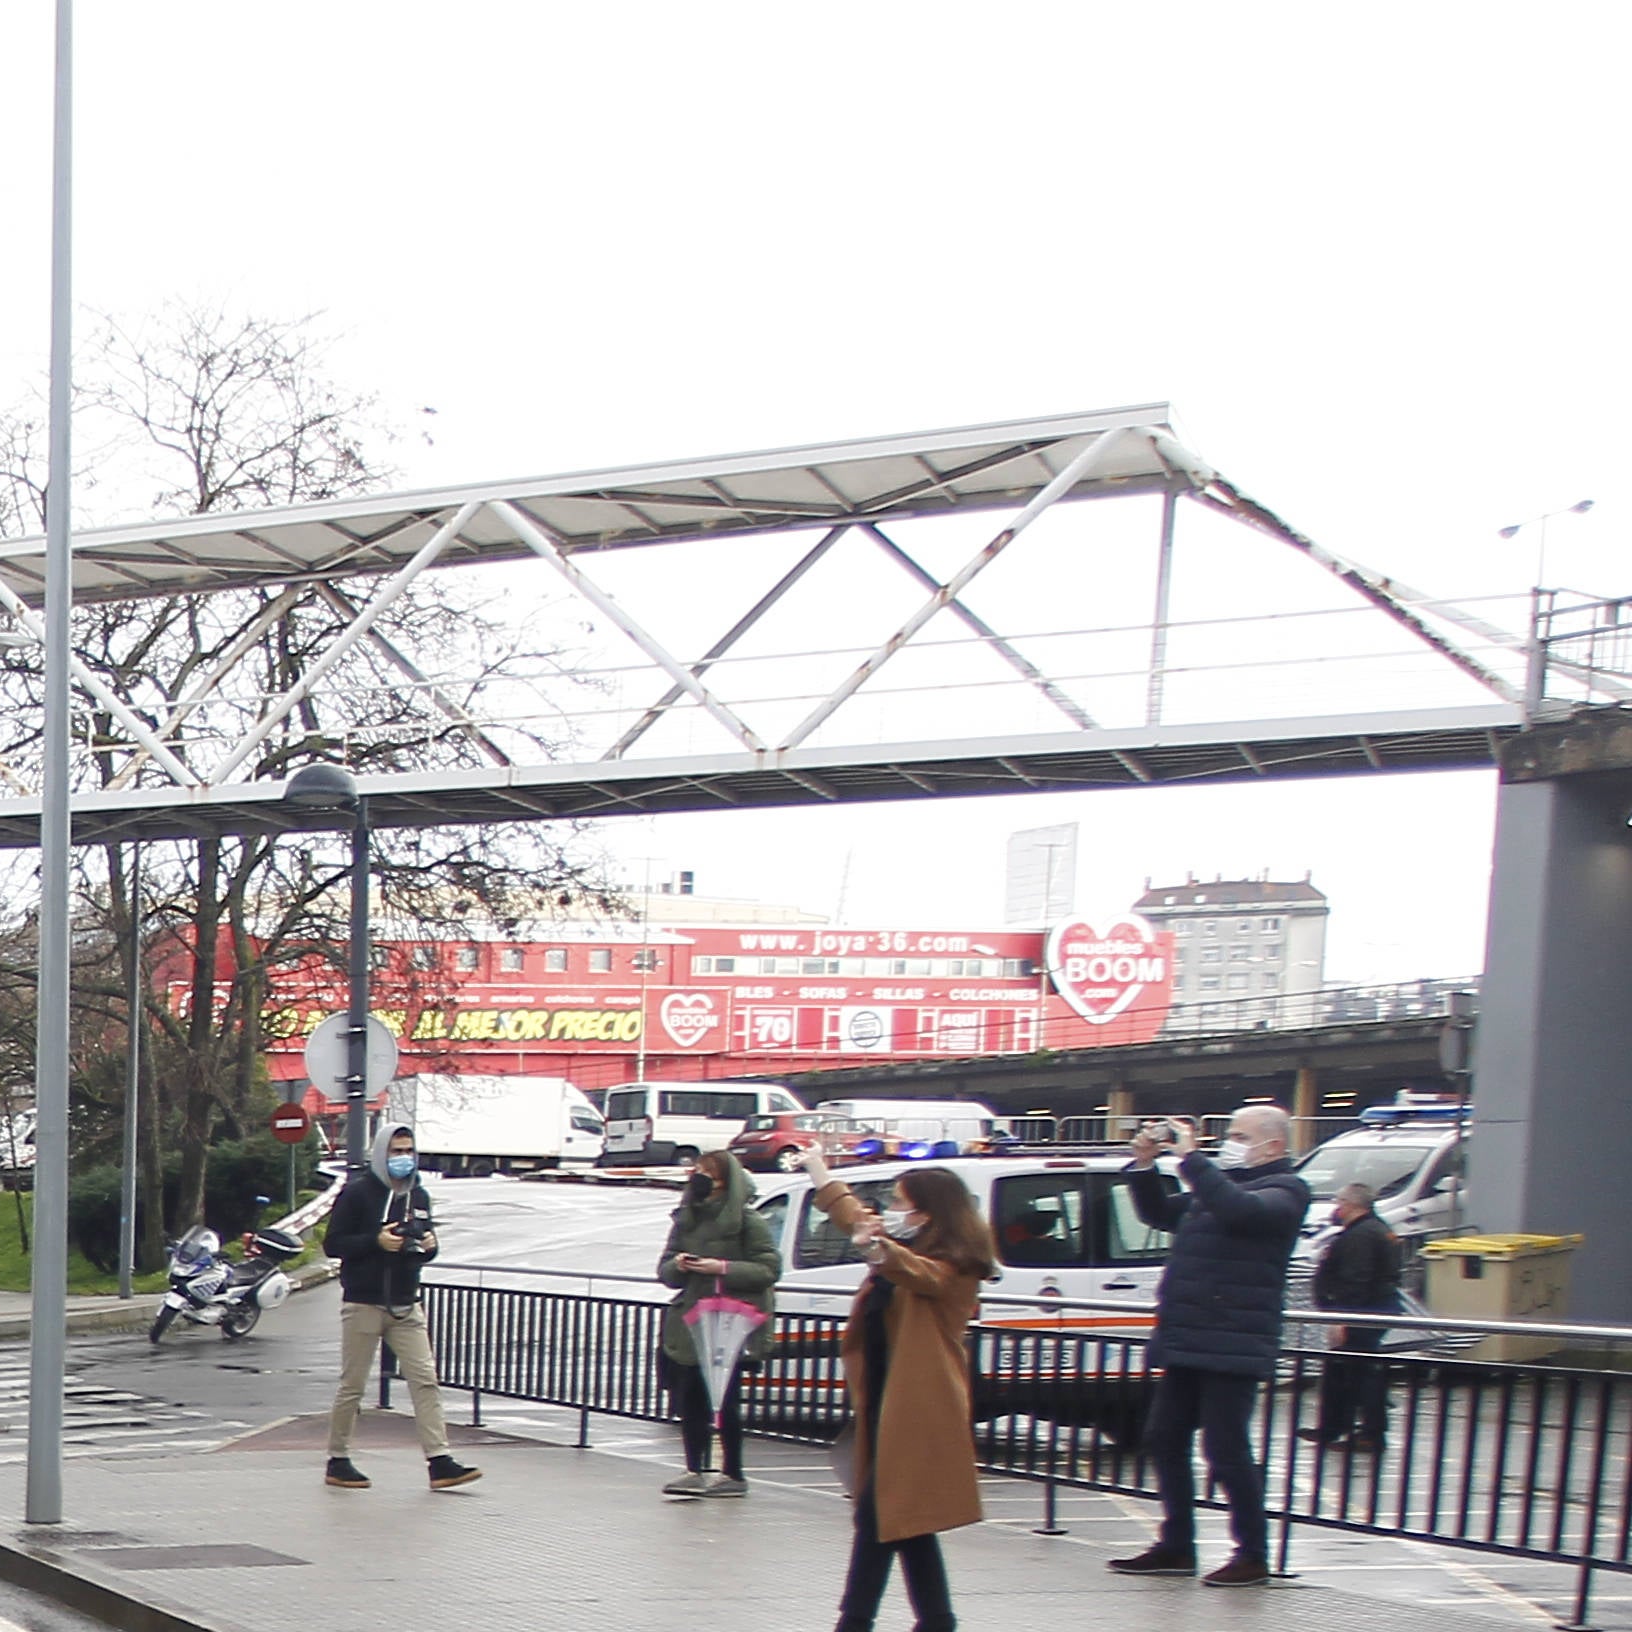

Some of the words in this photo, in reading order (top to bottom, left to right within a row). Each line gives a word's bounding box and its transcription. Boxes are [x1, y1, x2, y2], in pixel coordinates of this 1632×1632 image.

[1066, 940, 1144, 955] muebles
[1066, 957, 1165, 983] BOOM
[798, 986, 847, 999] SOFAS
[872, 987, 925, 1000] SILLAS
[949, 988, 1040, 1001] COLCHONES
[449, 1009, 549, 1041] MEJOR
[548, 1009, 643, 1041] PRECIO
[669, 1014, 719, 1029] BOOM
